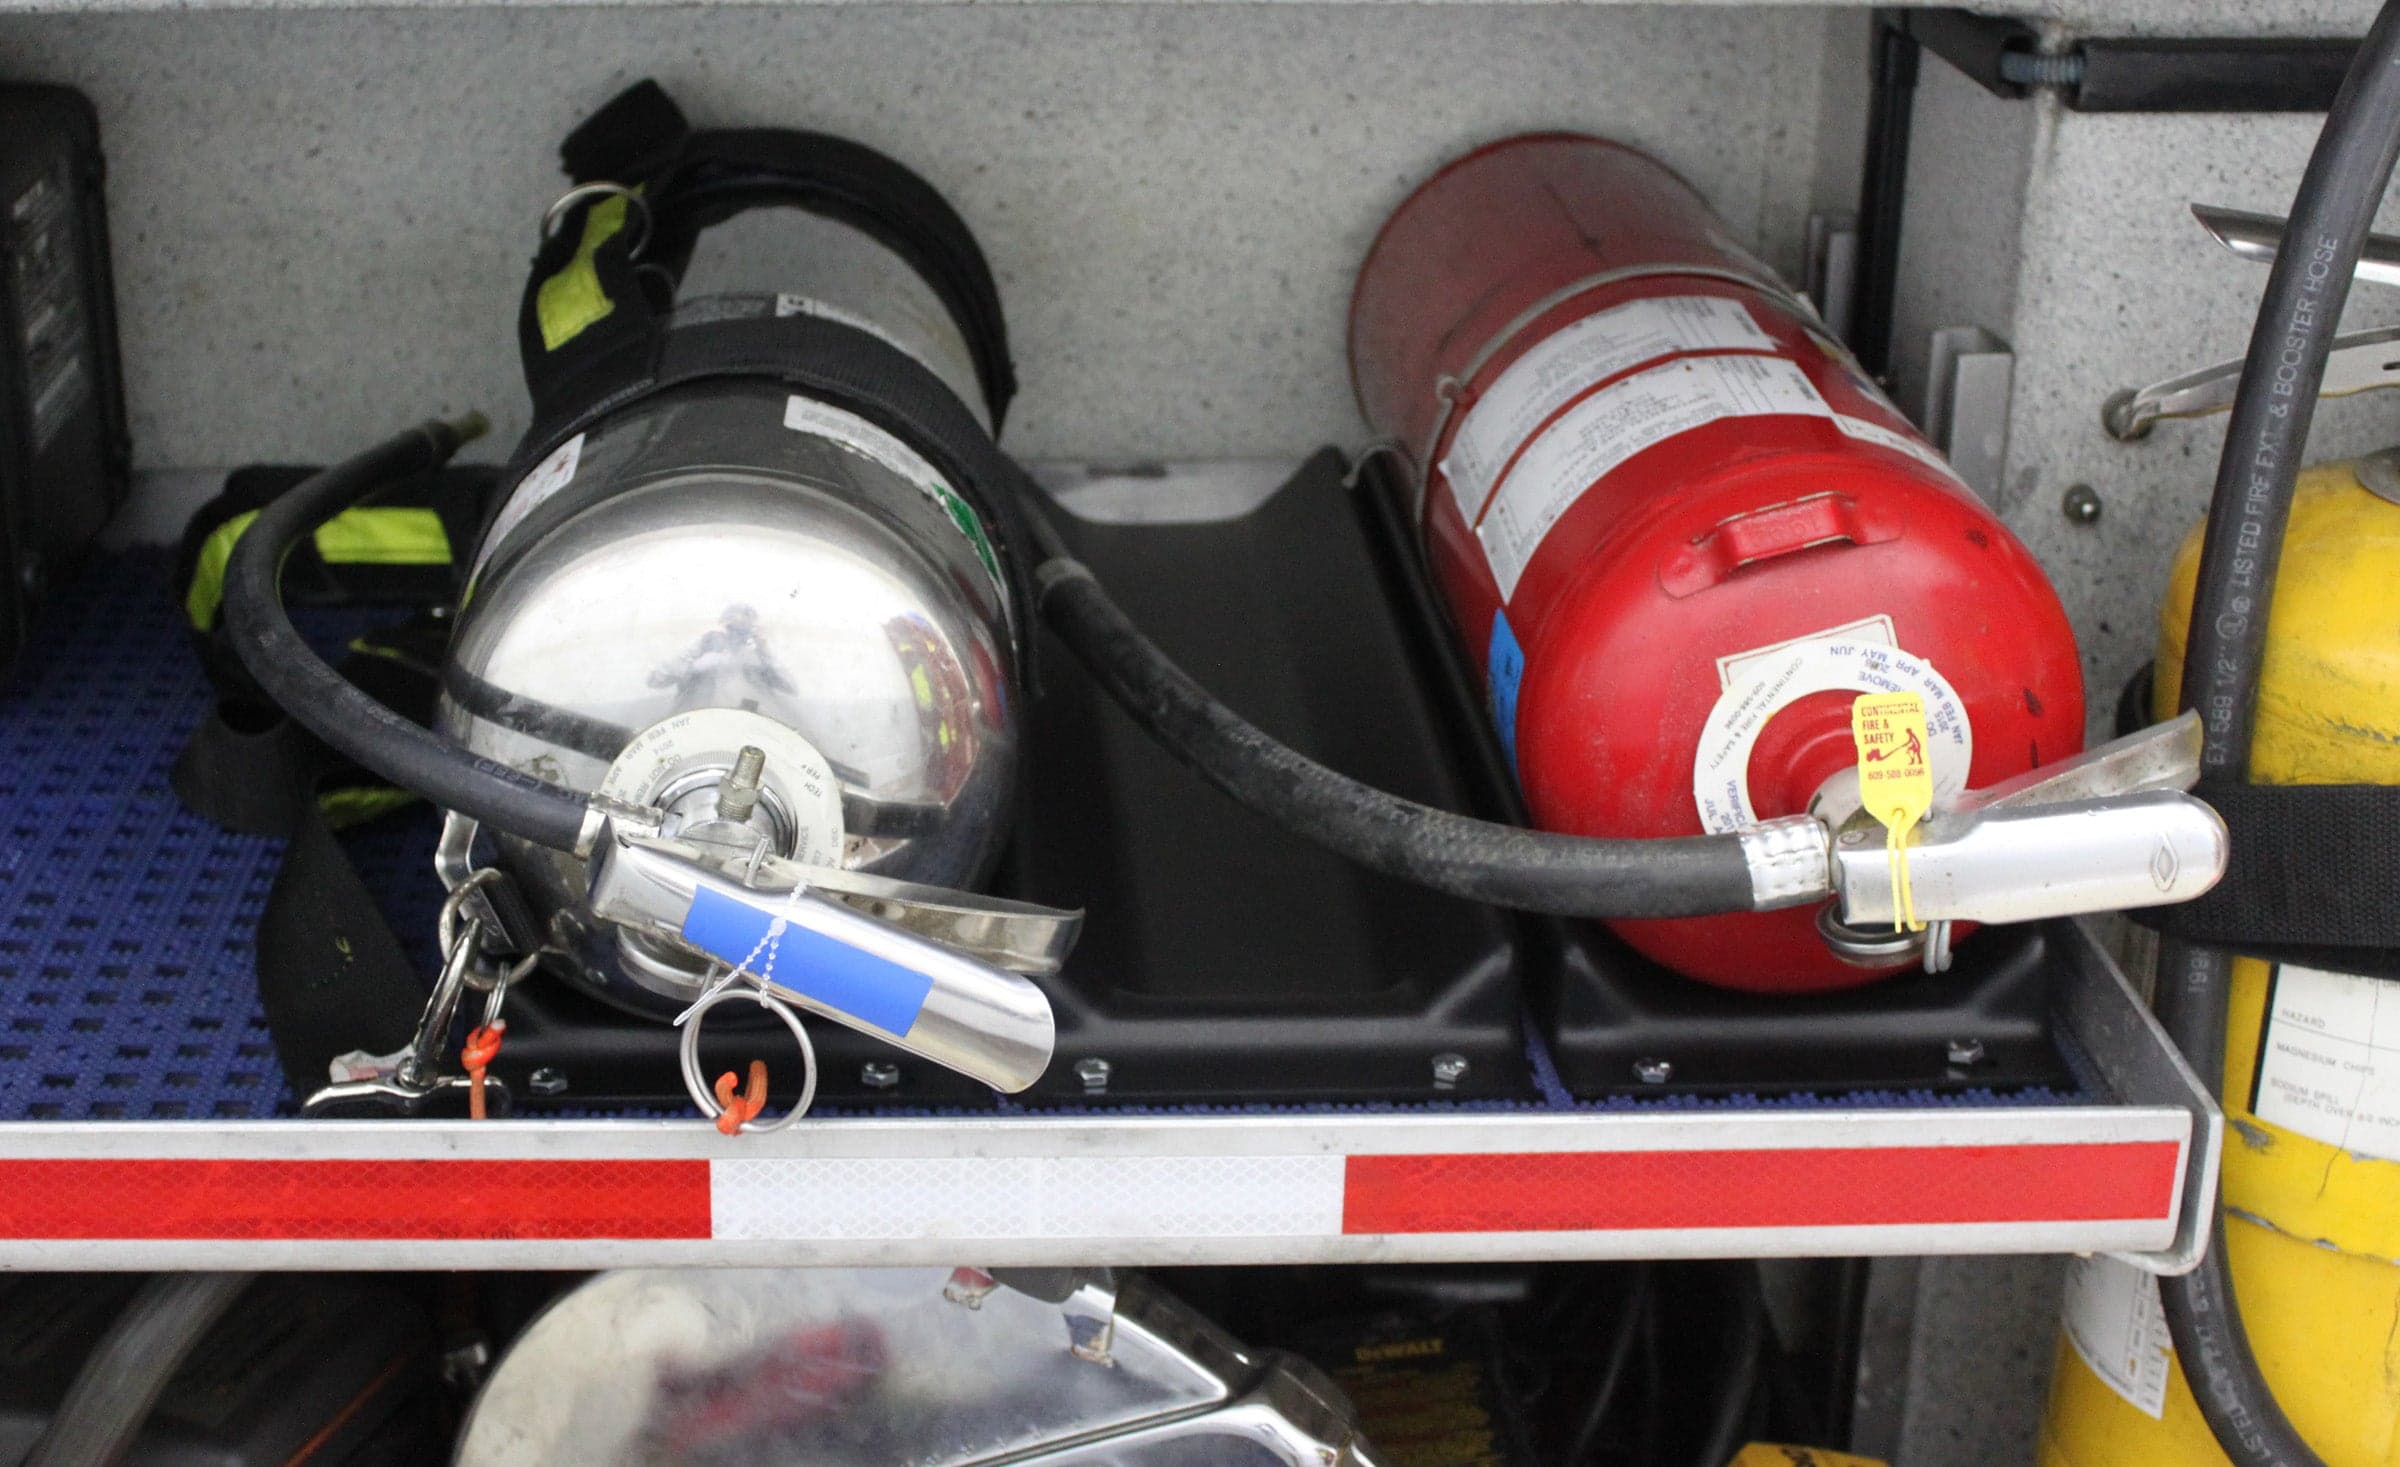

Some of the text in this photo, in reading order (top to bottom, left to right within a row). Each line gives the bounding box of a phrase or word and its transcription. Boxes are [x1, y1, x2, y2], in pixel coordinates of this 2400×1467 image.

[2303, 234, 2338, 292] HOSE
[2273, 297, 2315, 397] BOOSTER
[2270, 403, 2290, 418] &
[2254, 429, 2281, 468] EXT
[2246, 472, 2271, 516] FIRE
[2233, 520, 2263, 588] LISTED
[1829, 645, 1964, 745] JAN FEB MAR APR MAY JUN
[1862, 719, 1880, 731] FIRE
[1863, 732, 1895, 745] SAFETY
[1709, 739, 1736, 770] SAFETY
[2281, 1007, 2327, 1029] HAZARD
[2275, 1040, 2376, 1076] MAGNESIUM CHIPS
[2270, 1076, 2339, 1105] SODIUM SPILL
[2283, 1093, 2321, 1110] DEPTH
